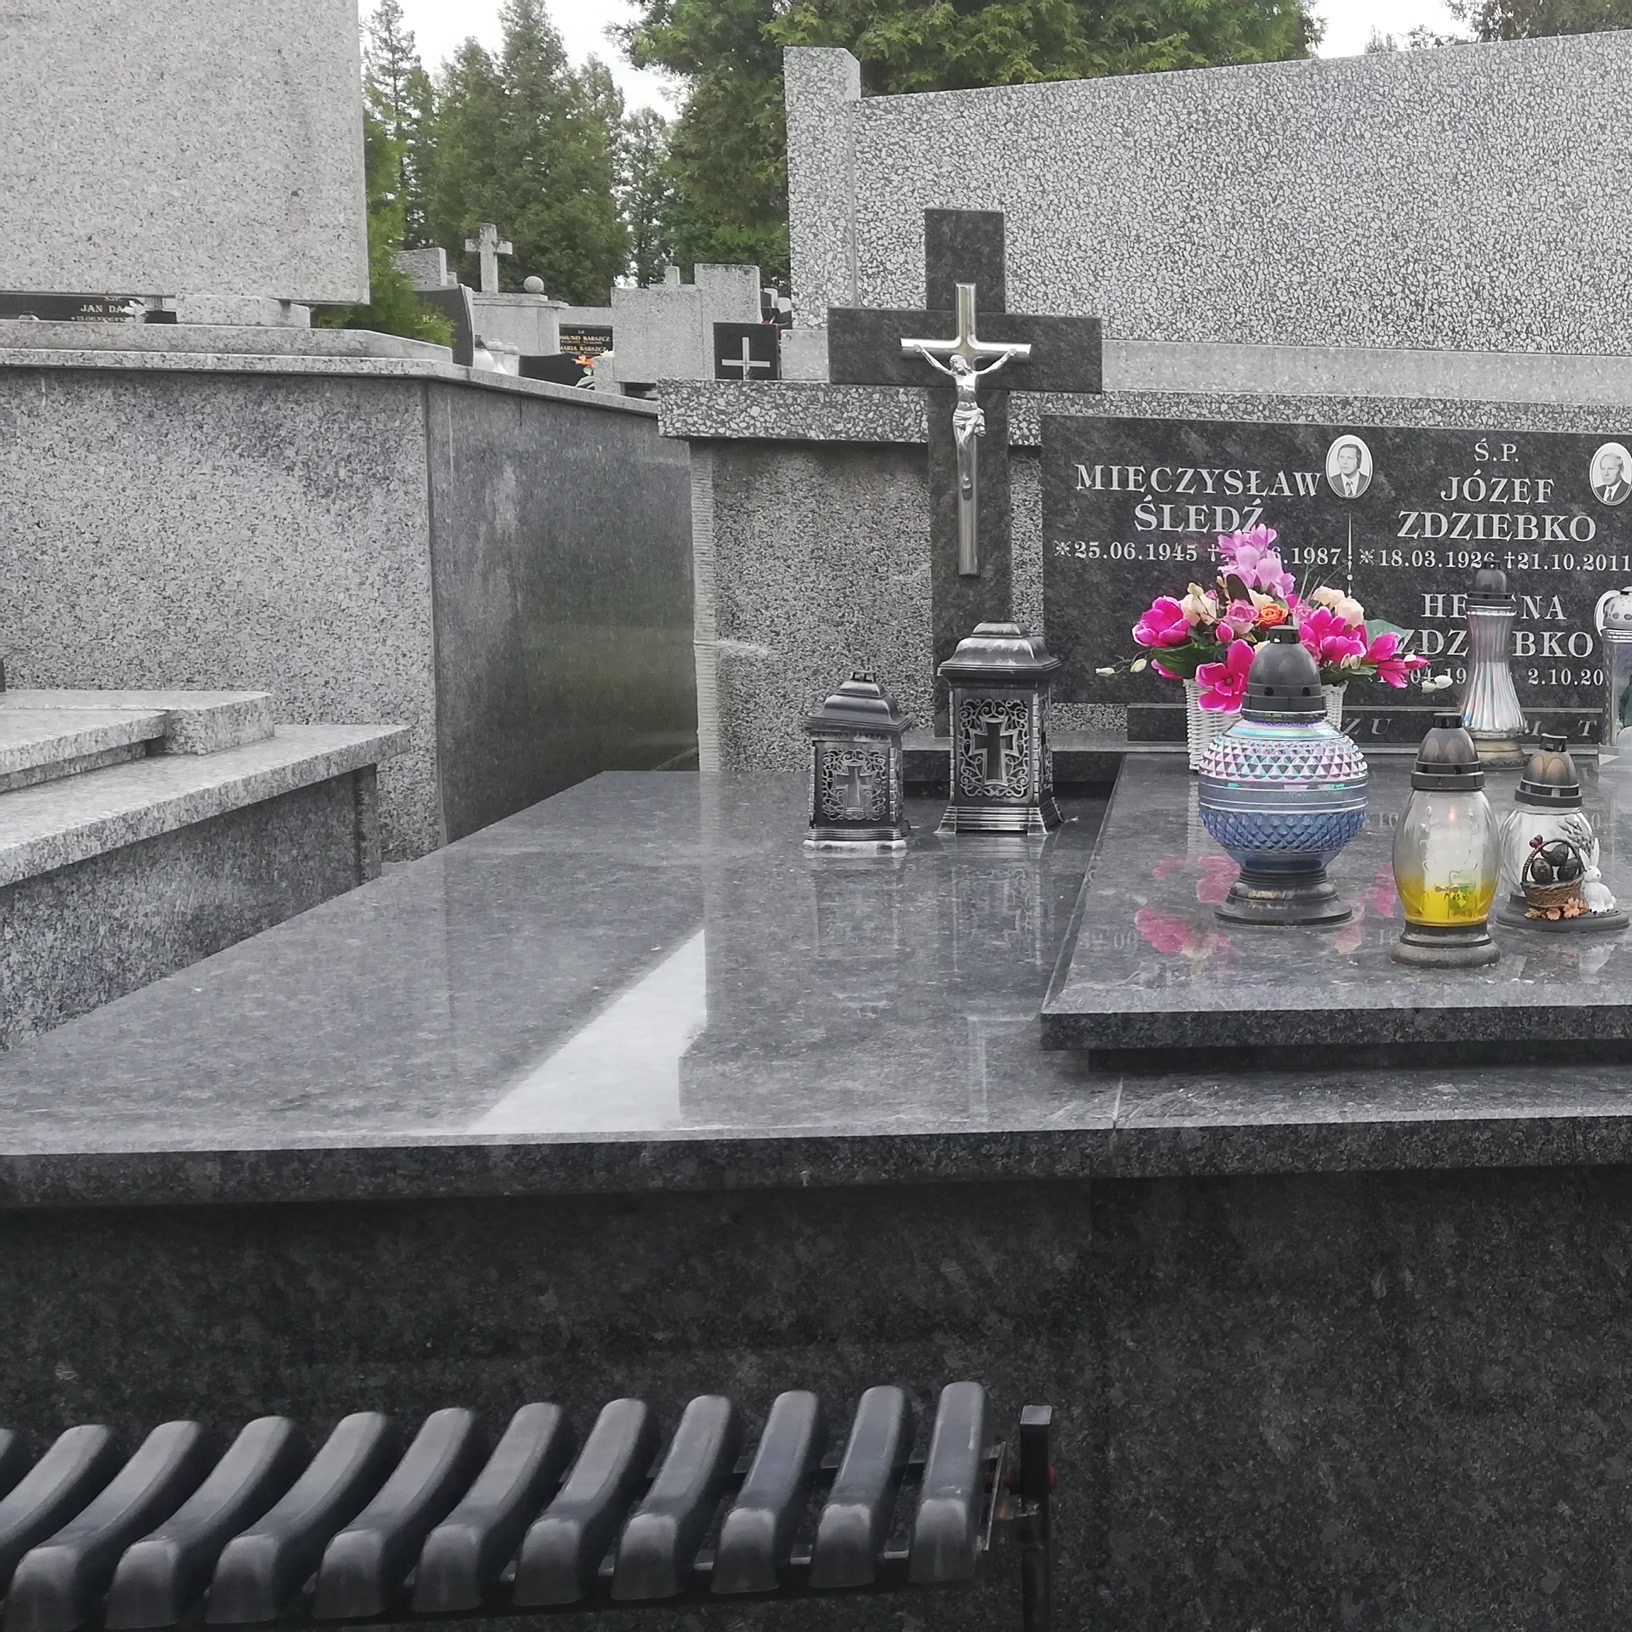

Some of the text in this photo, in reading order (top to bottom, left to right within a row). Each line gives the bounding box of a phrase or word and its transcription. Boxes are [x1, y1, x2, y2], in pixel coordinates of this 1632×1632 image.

[80, 304, 103, 313] JAN
[1074, 463, 1322, 498] MIECZYSŁAW
[1440, 468, 1555, 505] JÓZEF
[1134, 494, 1265, 534] ŚLEDŹ
[1396, 509, 1597, 543] ZDZIEBKO
[1420, 592, 1568, 621] HENA
[1395, 627, 1594, 659] ZDZBKO
